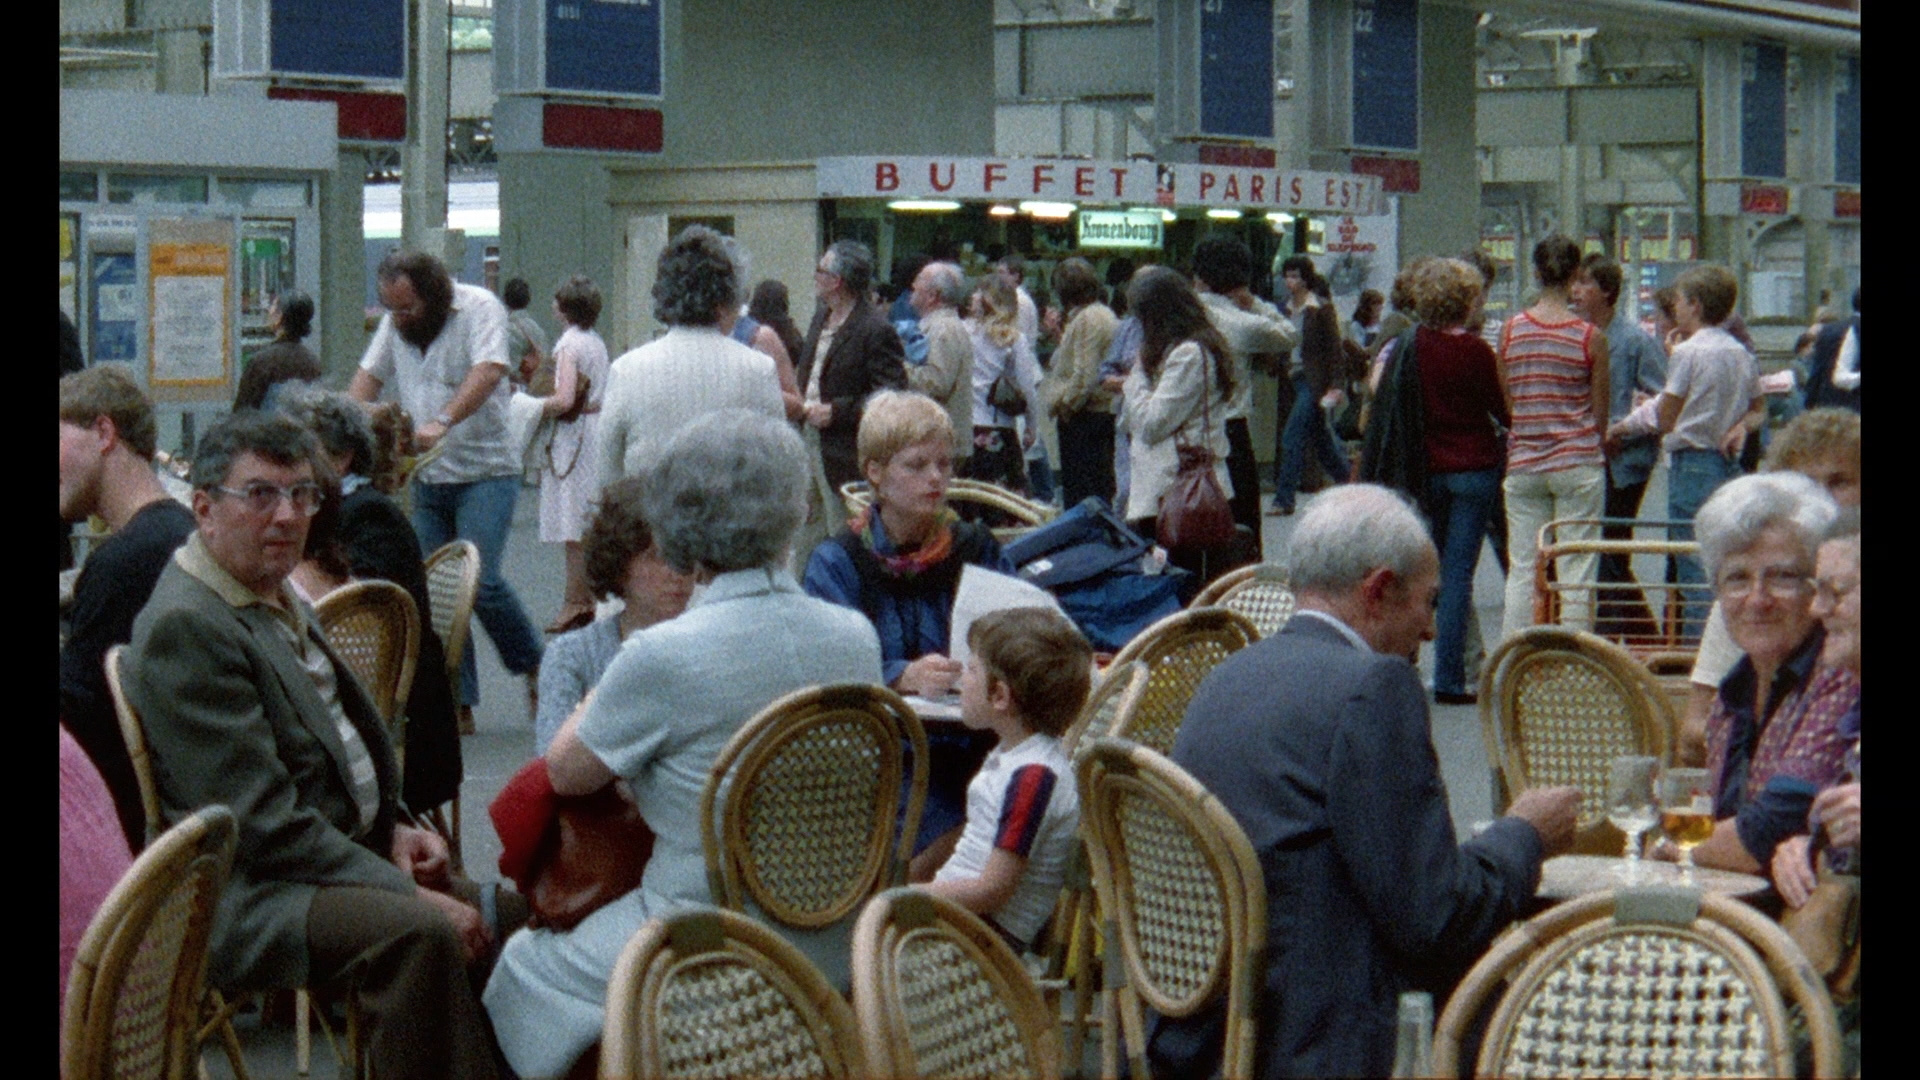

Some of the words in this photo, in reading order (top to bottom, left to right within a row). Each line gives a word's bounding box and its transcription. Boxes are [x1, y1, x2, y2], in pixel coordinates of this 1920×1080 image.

[1355, 9, 1373, 32] 22
[875, 162, 1128, 198] BUFFET
[1199, 171, 1303, 205] PARIS
[1325, 179, 1365, 208] EST
[1082, 214, 1158, 245] Kronenbourg
